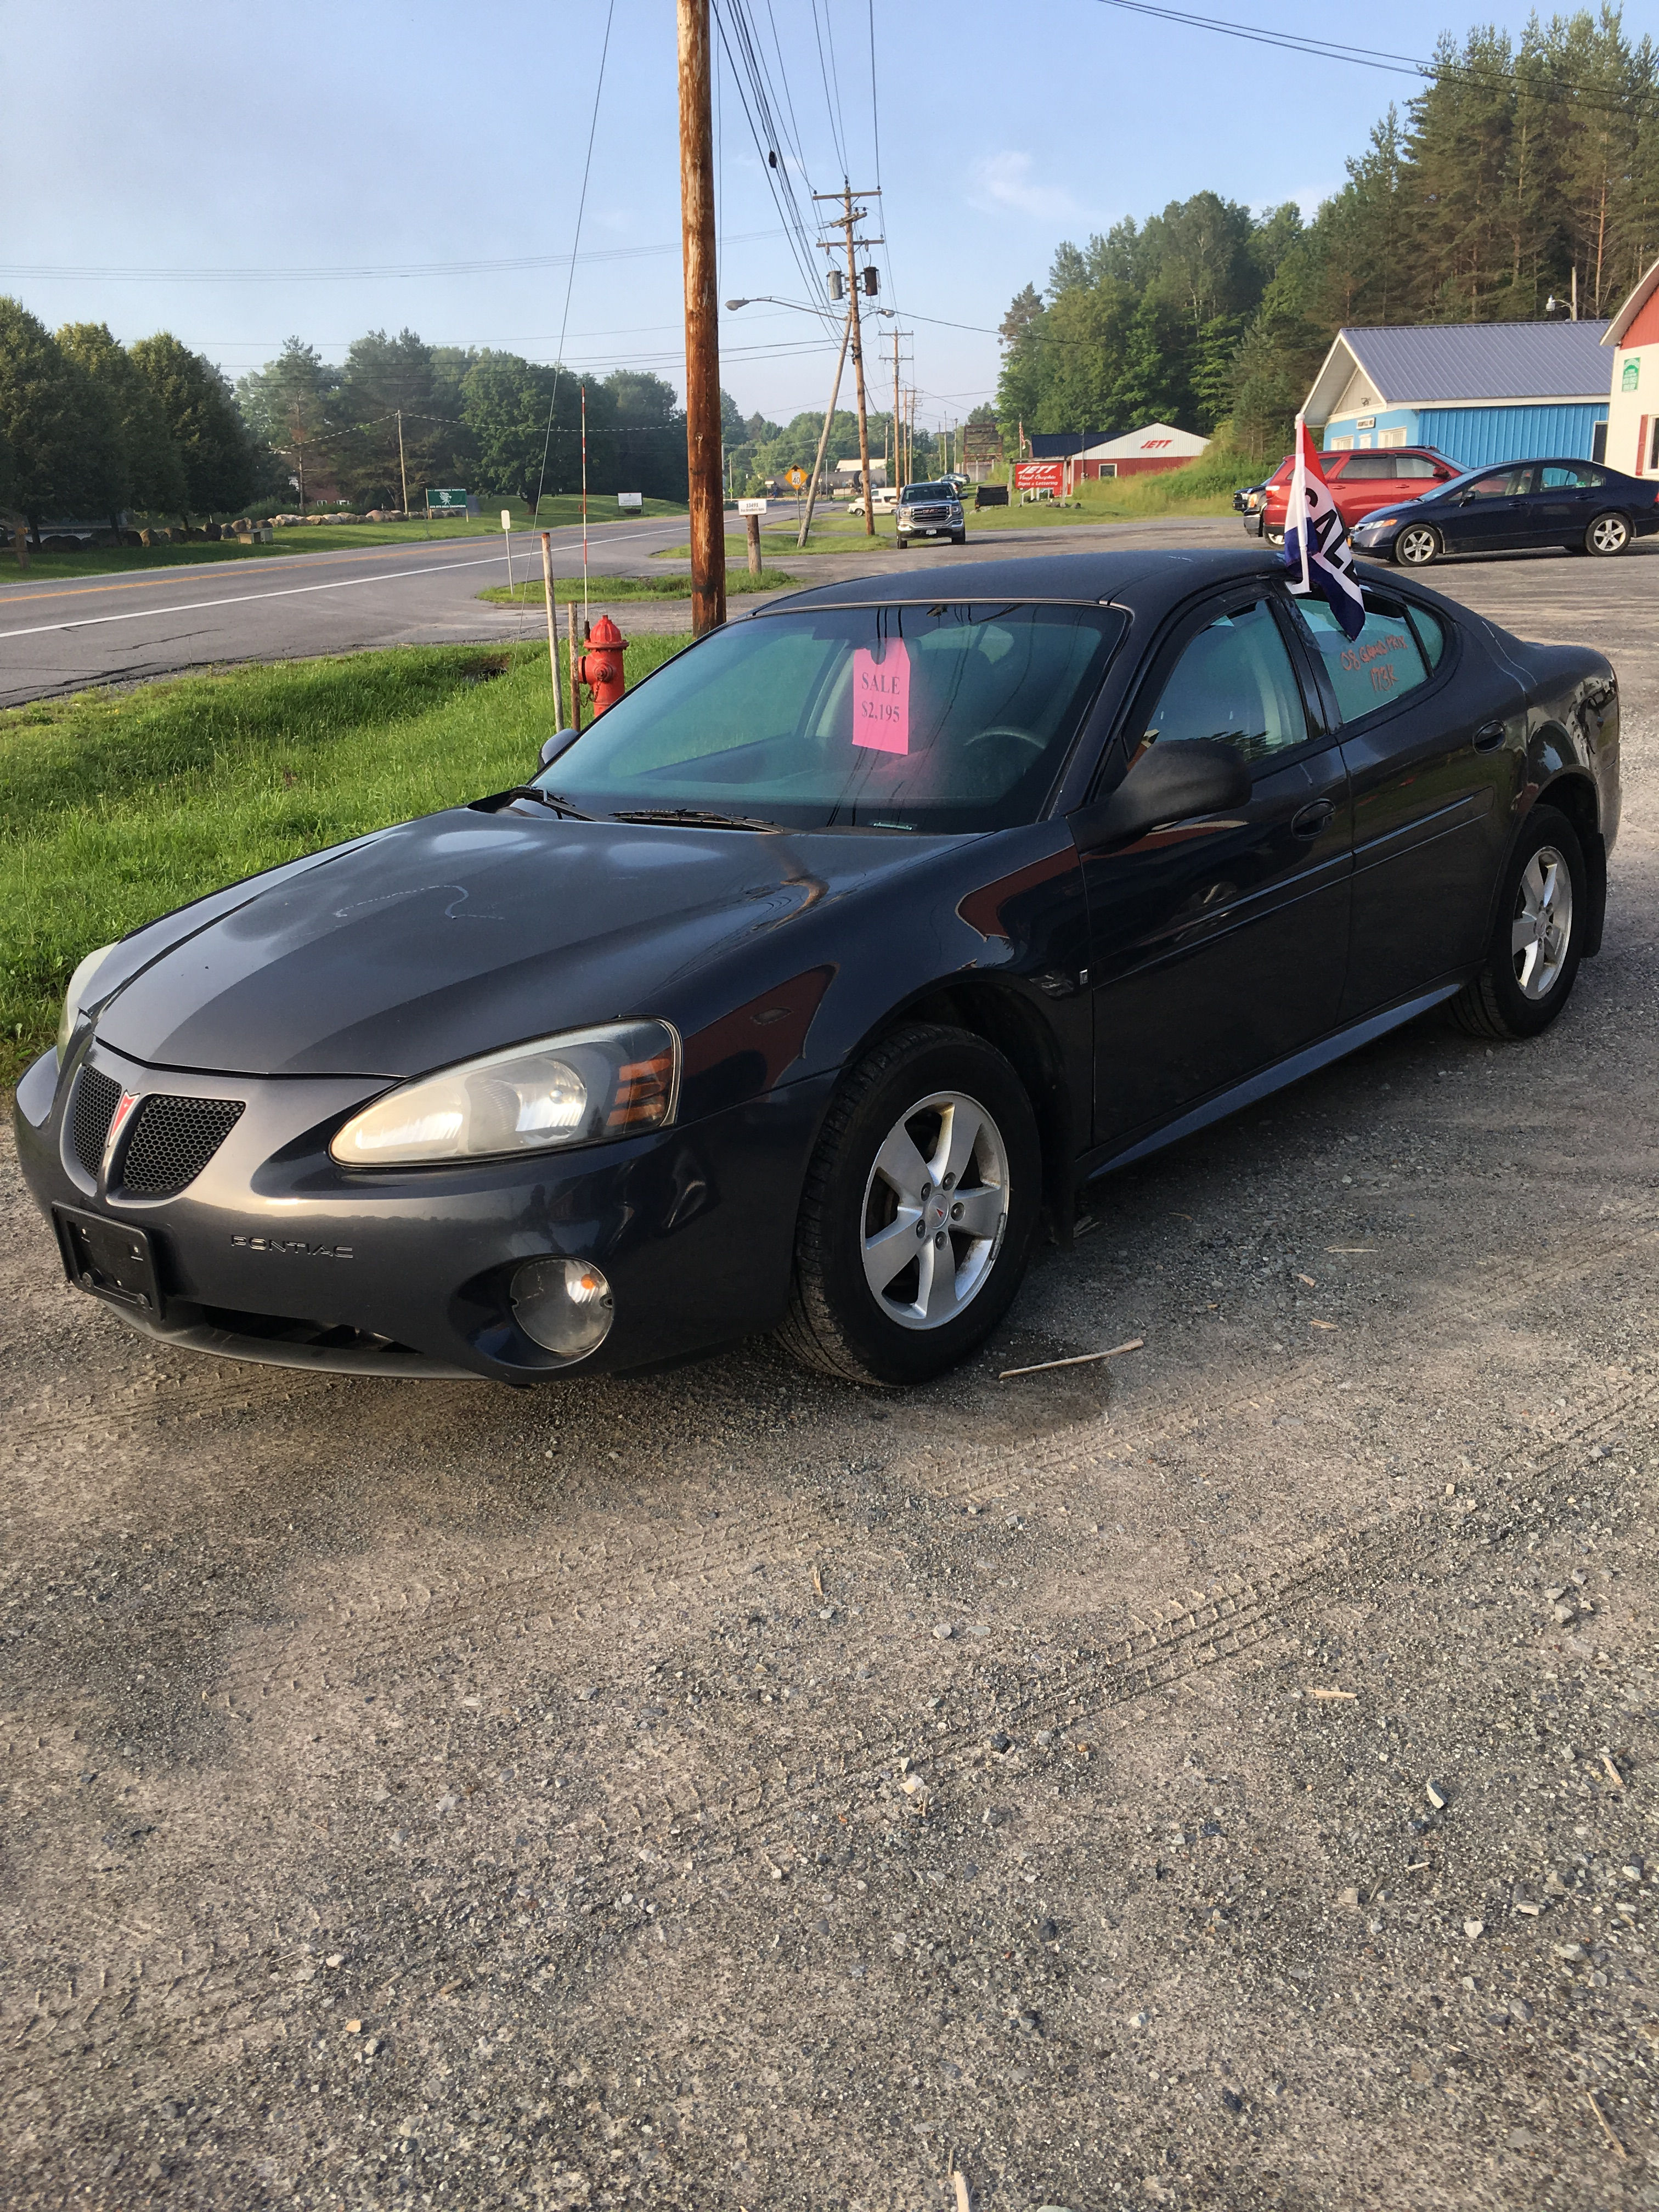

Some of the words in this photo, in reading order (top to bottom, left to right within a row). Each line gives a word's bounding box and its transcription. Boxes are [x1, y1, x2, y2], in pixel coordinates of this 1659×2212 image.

[1141, 439, 1172, 448] JETT
[1018, 465, 1058, 474] JETT
[1340, 649, 1361, 671] 08
[862, 672, 900, 695] SALE
[1370, 664, 1398, 693] 173K
[861, 700, 900, 723] $2,195
[231, 1234, 354, 1259] PONTIAC
